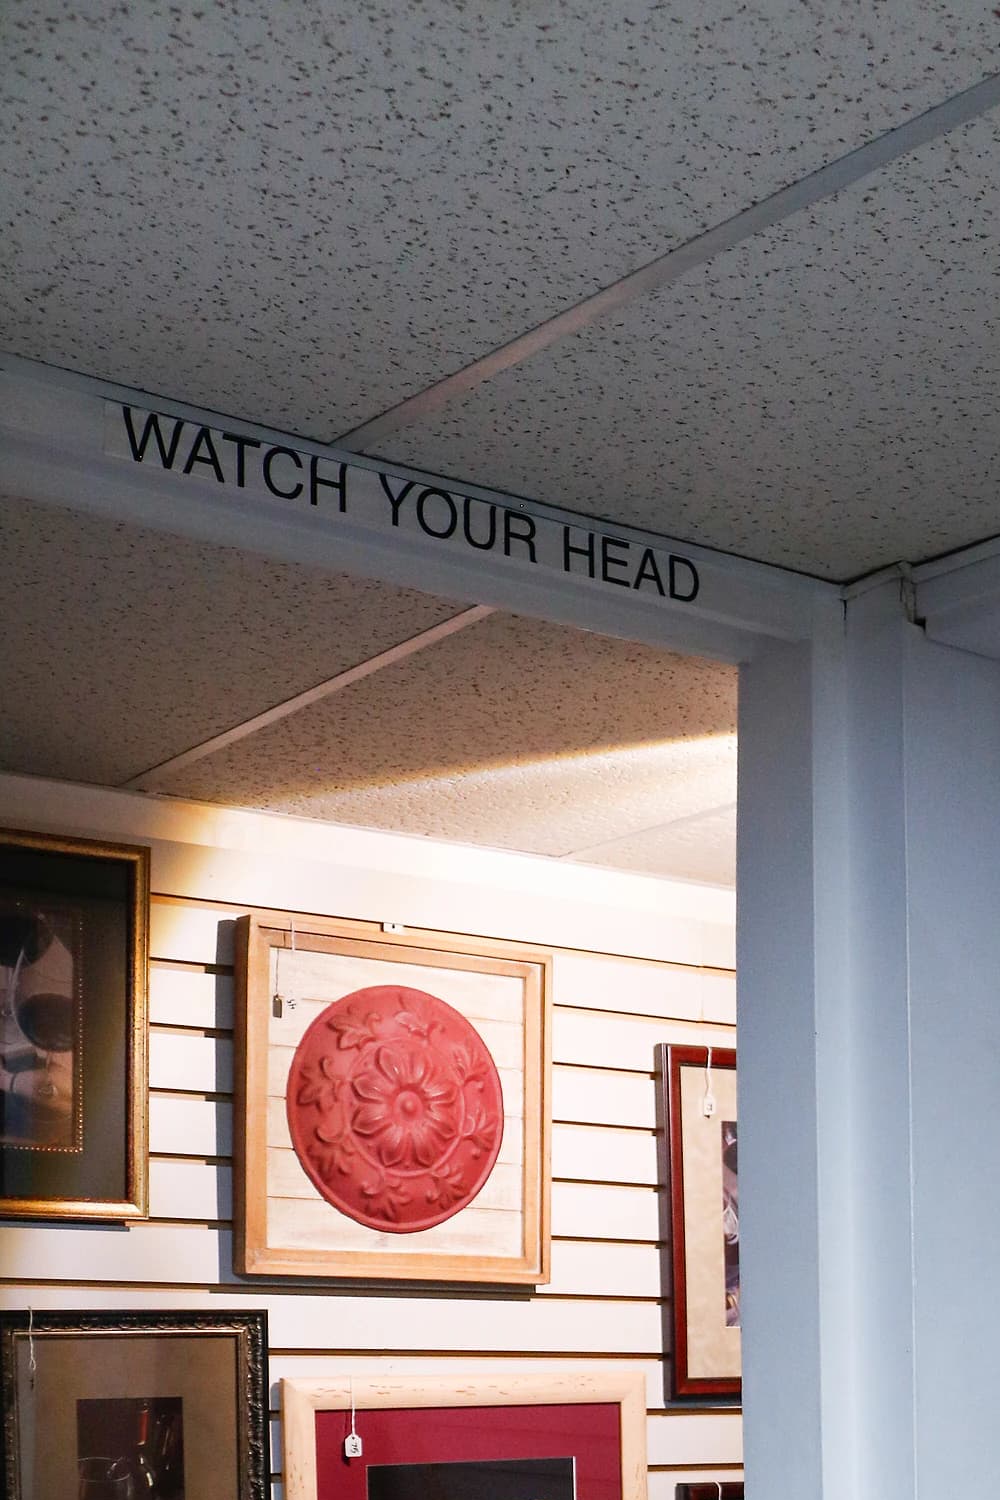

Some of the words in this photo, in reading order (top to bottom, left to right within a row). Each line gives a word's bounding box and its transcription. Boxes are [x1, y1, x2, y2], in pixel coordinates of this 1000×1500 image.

[122, 405, 347, 513] WATCH
[378, 472, 538, 563] YOUR
[563, 526, 700, 602] HEAD
